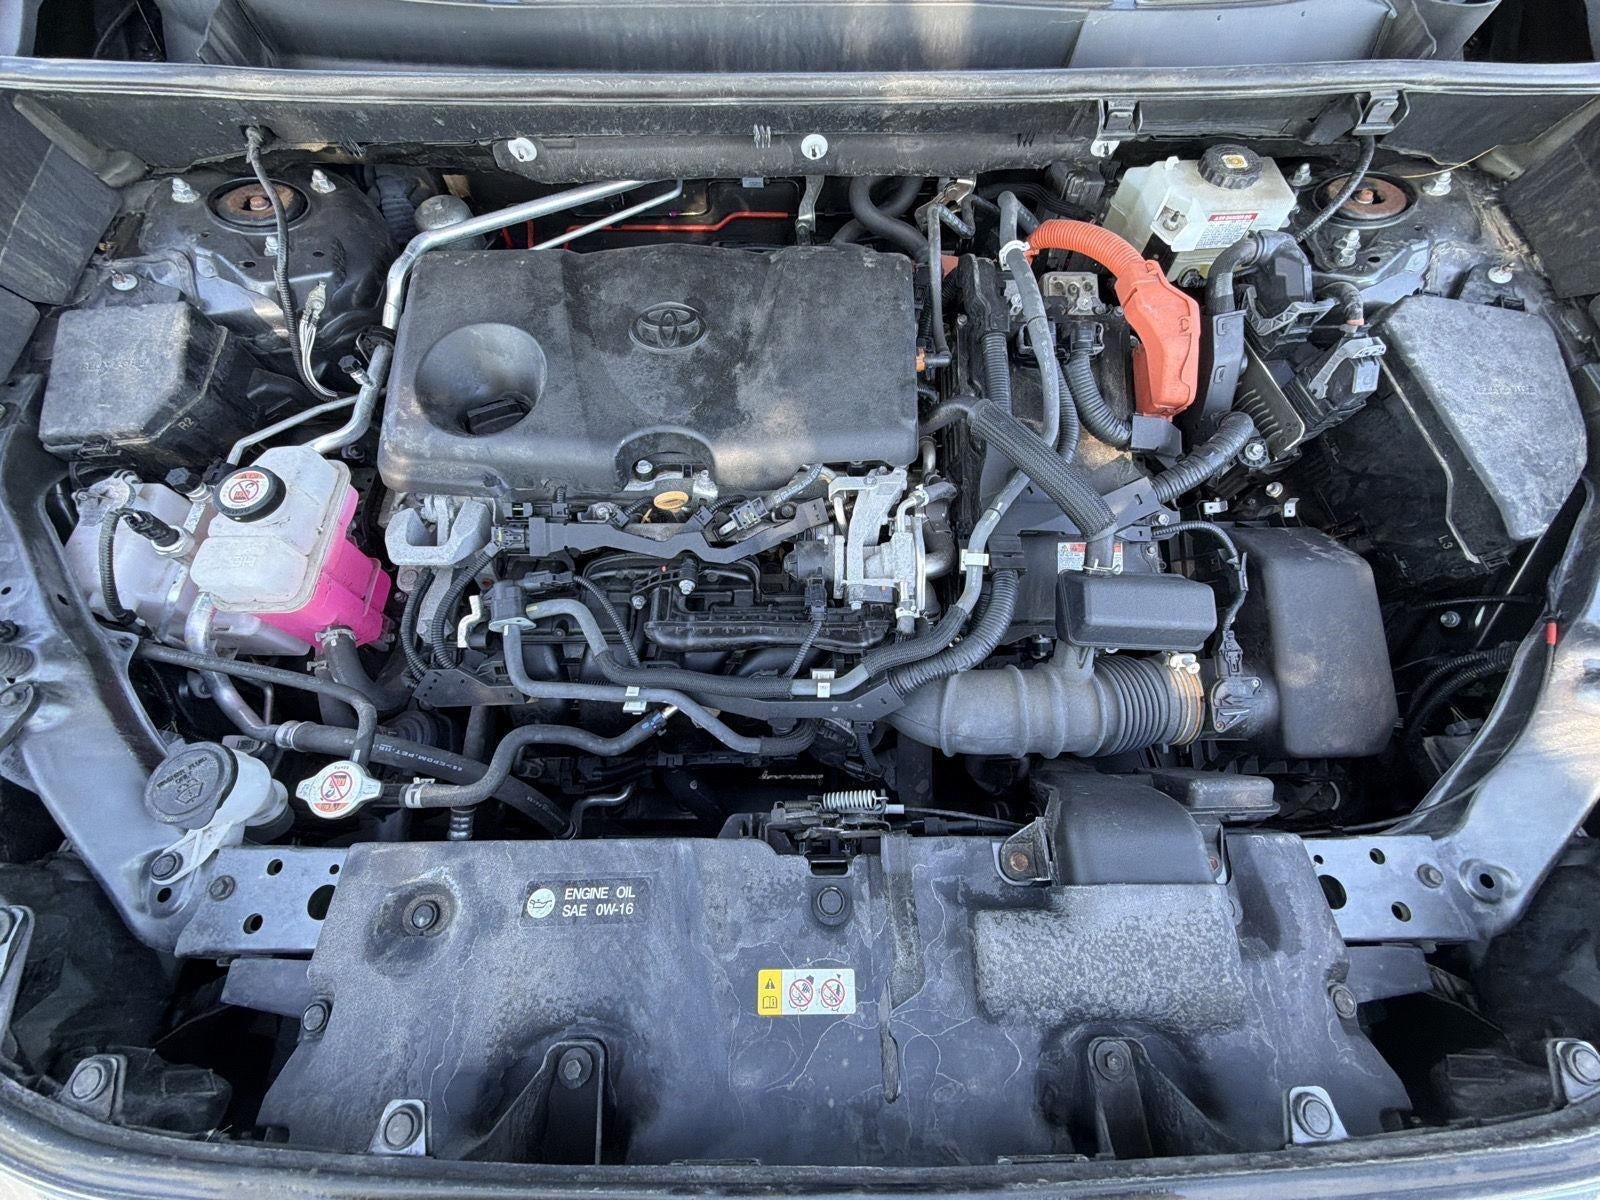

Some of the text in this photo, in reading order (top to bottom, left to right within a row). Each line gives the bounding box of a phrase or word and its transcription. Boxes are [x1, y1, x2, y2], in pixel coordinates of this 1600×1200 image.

[177, 417, 194, 431] R2
[1438, 534, 1453, 549] L3
[564, 885, 636, 900] ENGINE OIL
[562, 902, 634, 918] SAE 0W-16
